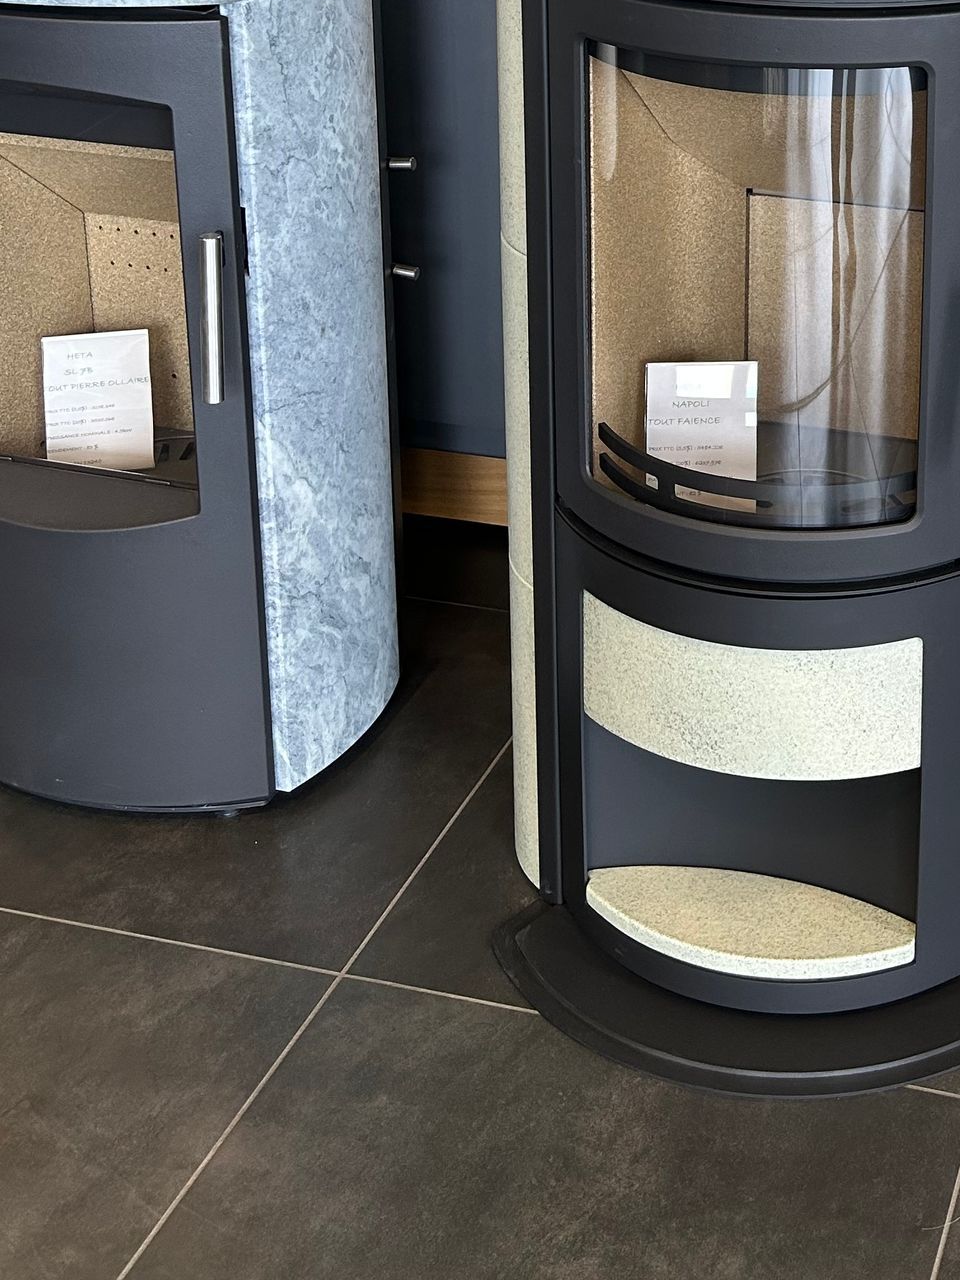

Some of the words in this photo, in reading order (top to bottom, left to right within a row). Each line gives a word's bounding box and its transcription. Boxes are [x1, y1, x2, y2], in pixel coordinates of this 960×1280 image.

[67, 351, 93, 360] HETA
[70, 380, 105, 390] PIERRE
[107, 376, 149, 387] OLLAIRE
[672, 400, 710, 409] NAPOLI
[648, 418, 676, 426] TOUT
[677, 416, 721, 426] FAIENCE
